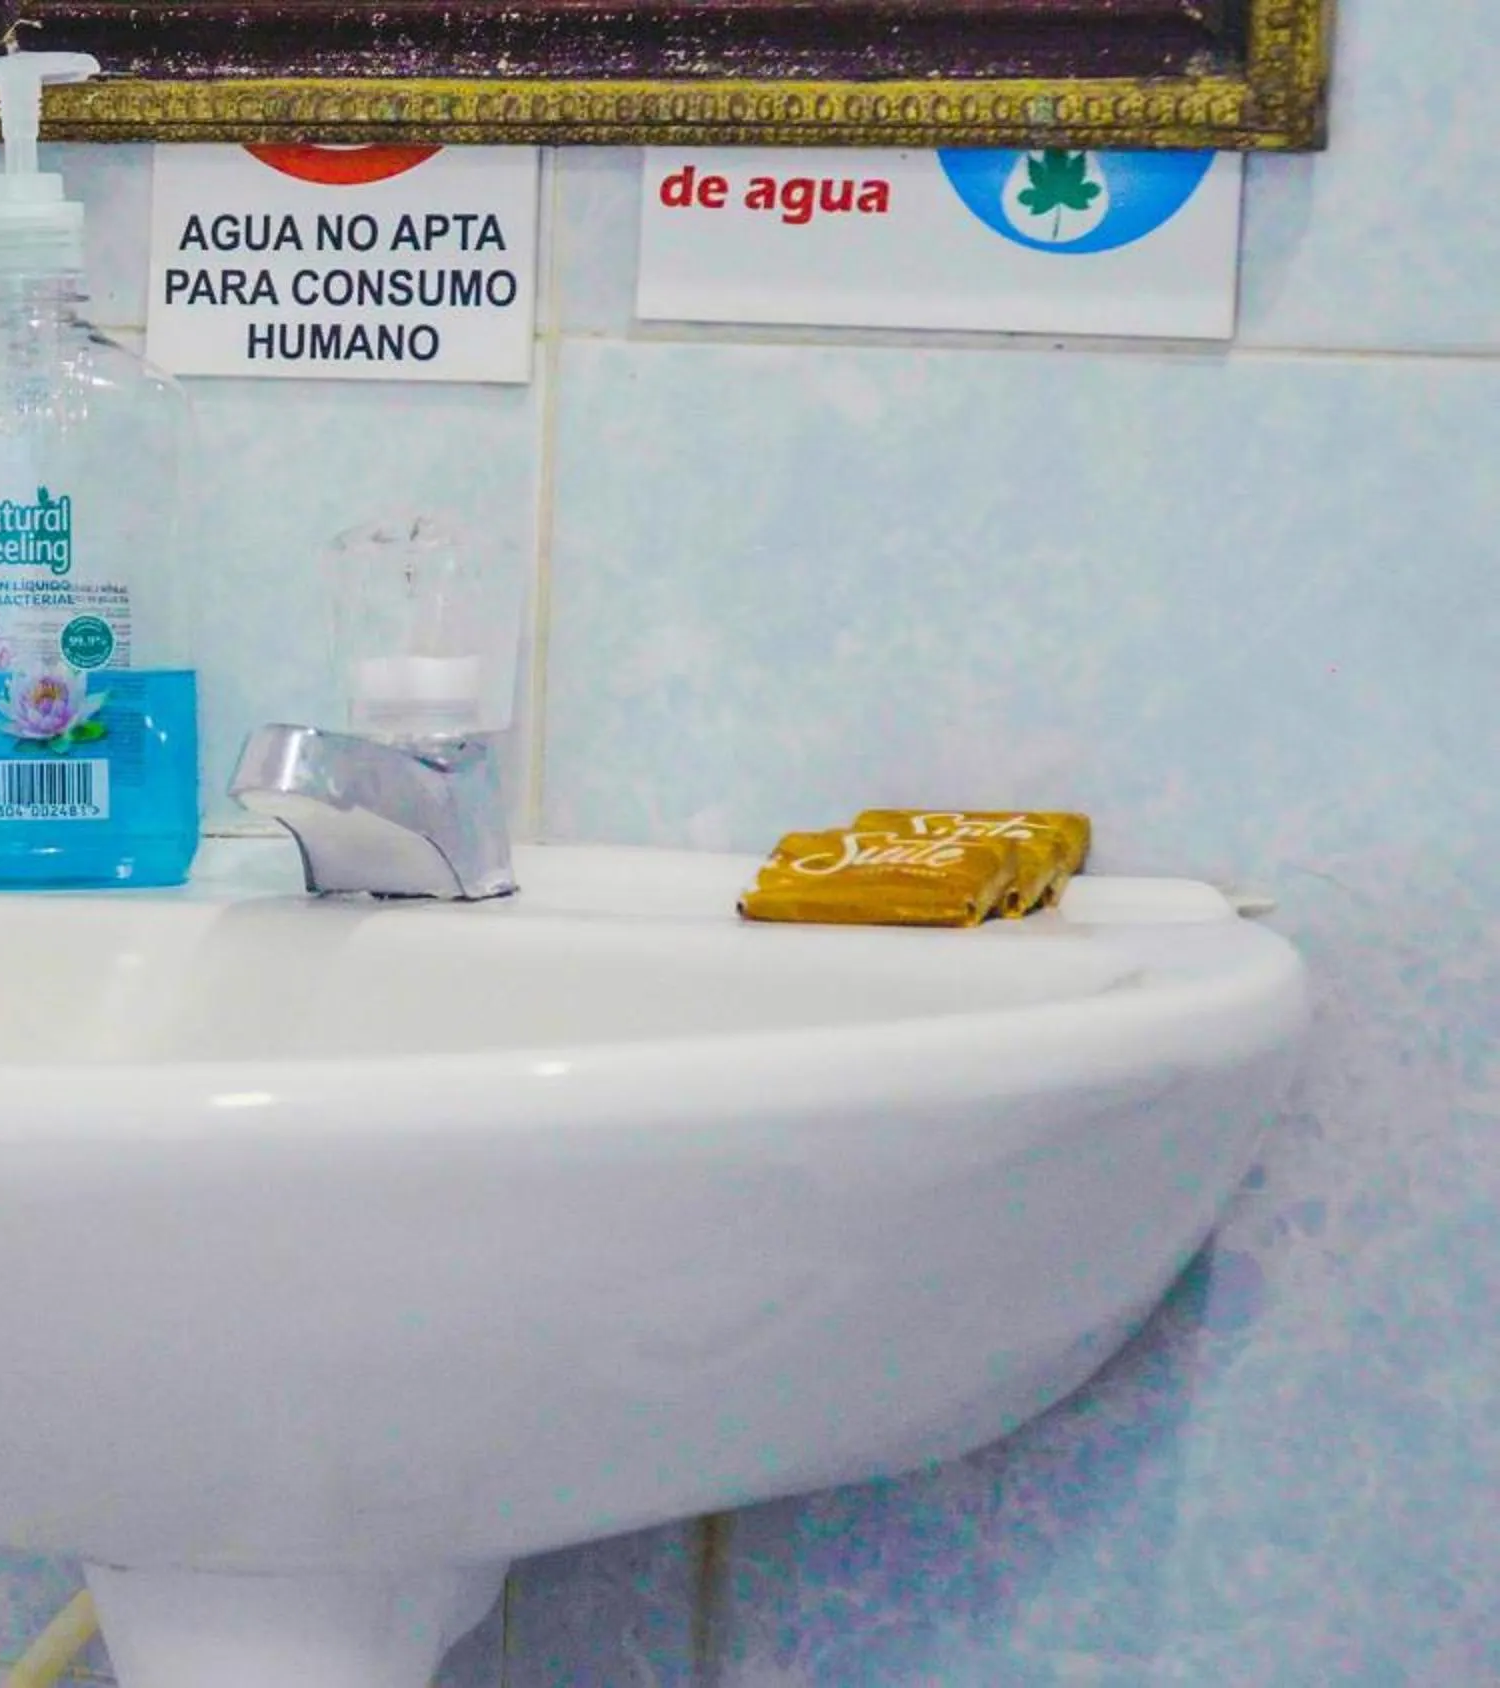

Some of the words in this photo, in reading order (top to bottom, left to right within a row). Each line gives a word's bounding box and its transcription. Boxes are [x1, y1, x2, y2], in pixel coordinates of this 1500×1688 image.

[659, 165, 729, 209] de
[744, 176, 890, 225] agua
[178, 213, 304, 251] AGUA
[316, 213, 379, 252] NO
[389, 213, 507, 251] APTA
[164, 268, 279, 306] PARA
[291, 268, 518, 307] CONSUMO
[246, 322, 440, 362] HUMANO
